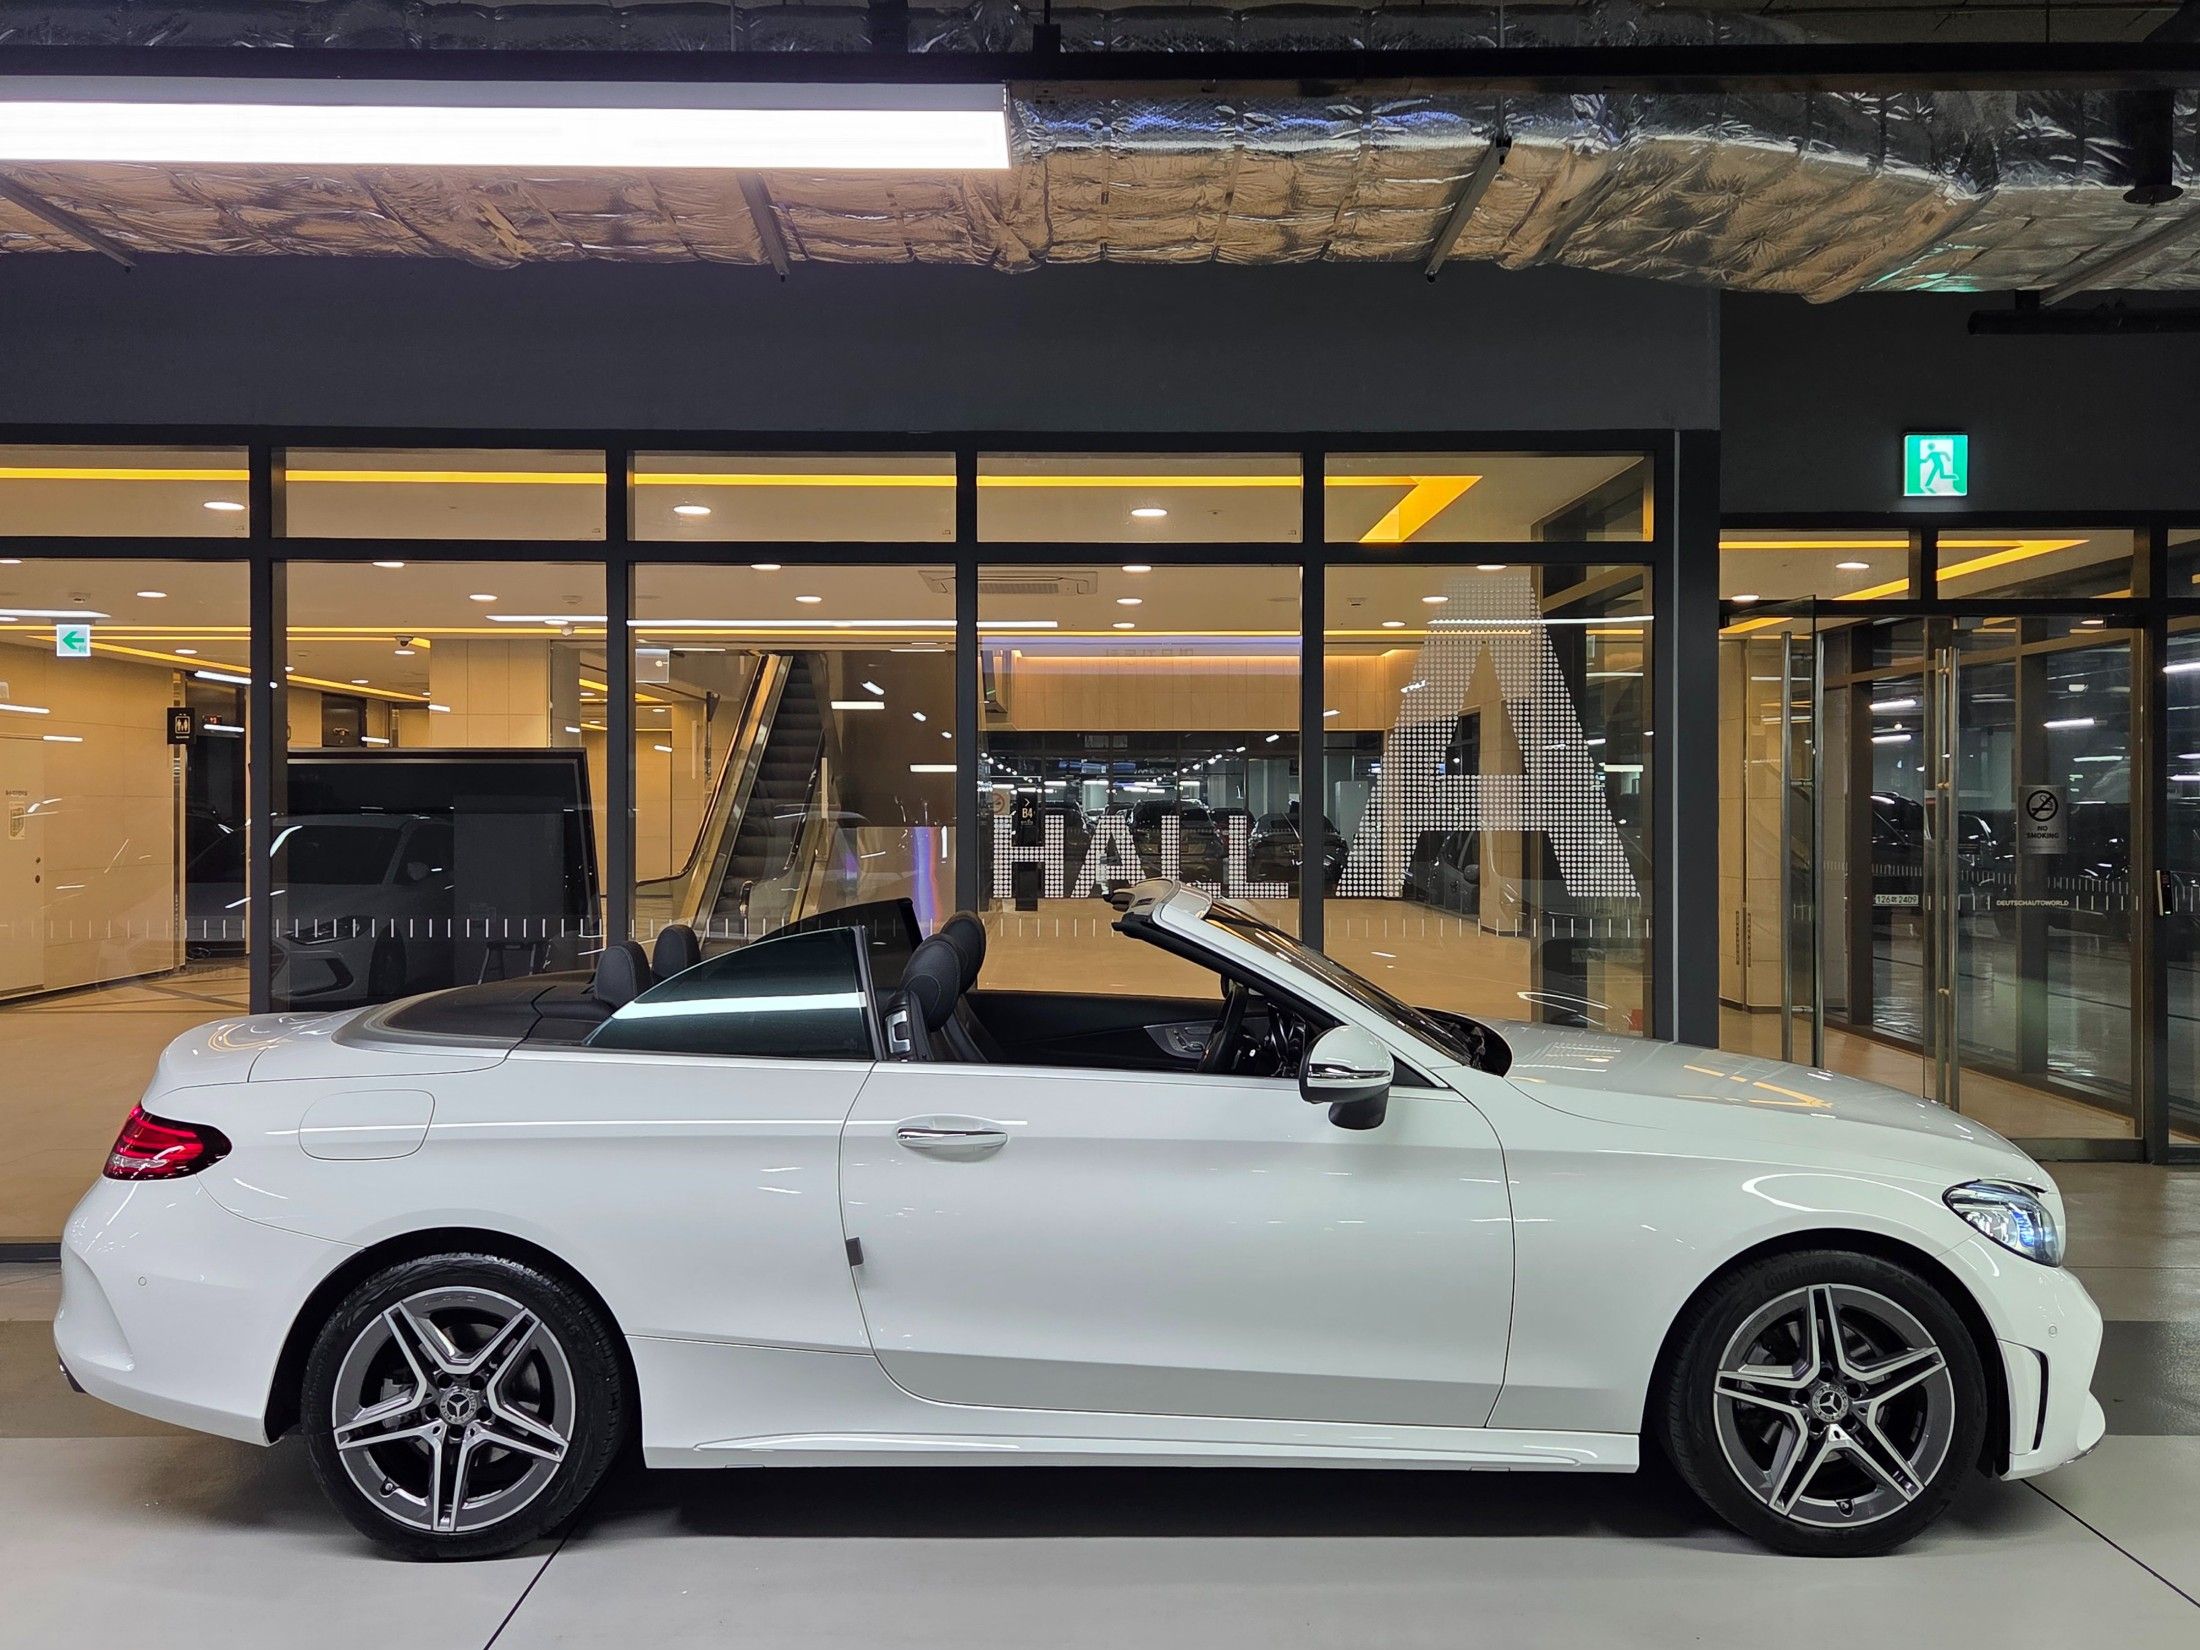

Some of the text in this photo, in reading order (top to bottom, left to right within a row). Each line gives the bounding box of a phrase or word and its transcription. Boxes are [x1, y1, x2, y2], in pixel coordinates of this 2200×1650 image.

[993, 574, 1641, 898] HALL A
[1022, 807, 1033, 819] B4
